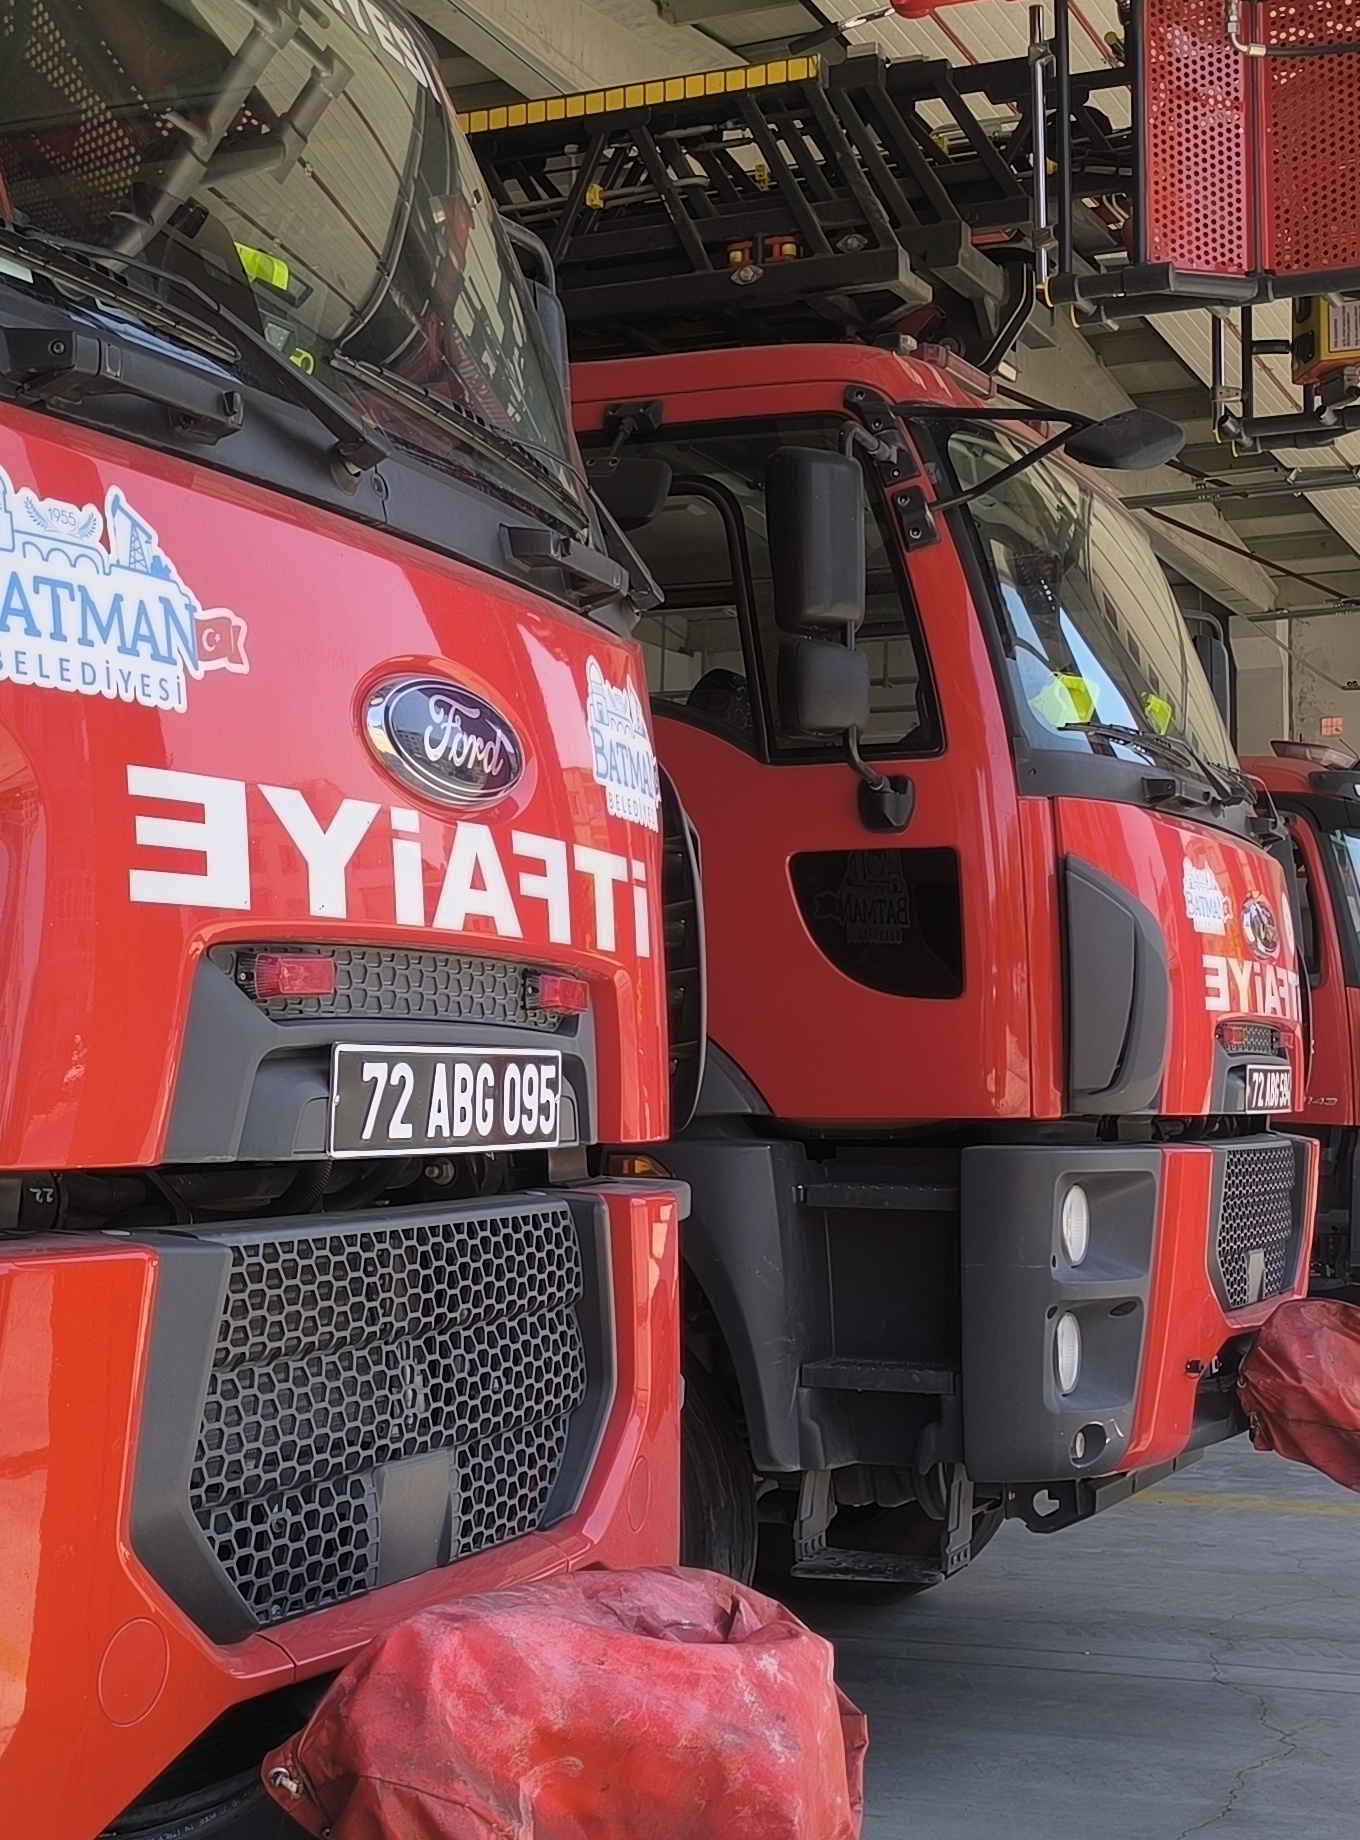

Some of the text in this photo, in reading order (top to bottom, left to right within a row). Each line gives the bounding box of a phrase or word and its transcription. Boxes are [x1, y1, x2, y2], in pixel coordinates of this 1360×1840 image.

[46, 506, 77, 527] 1955
[424, 694, 515, 776] Ford
[361, 1062, 557, 1140] 72 ABG 095
[1251, 1072, 1265, 1108] 72
